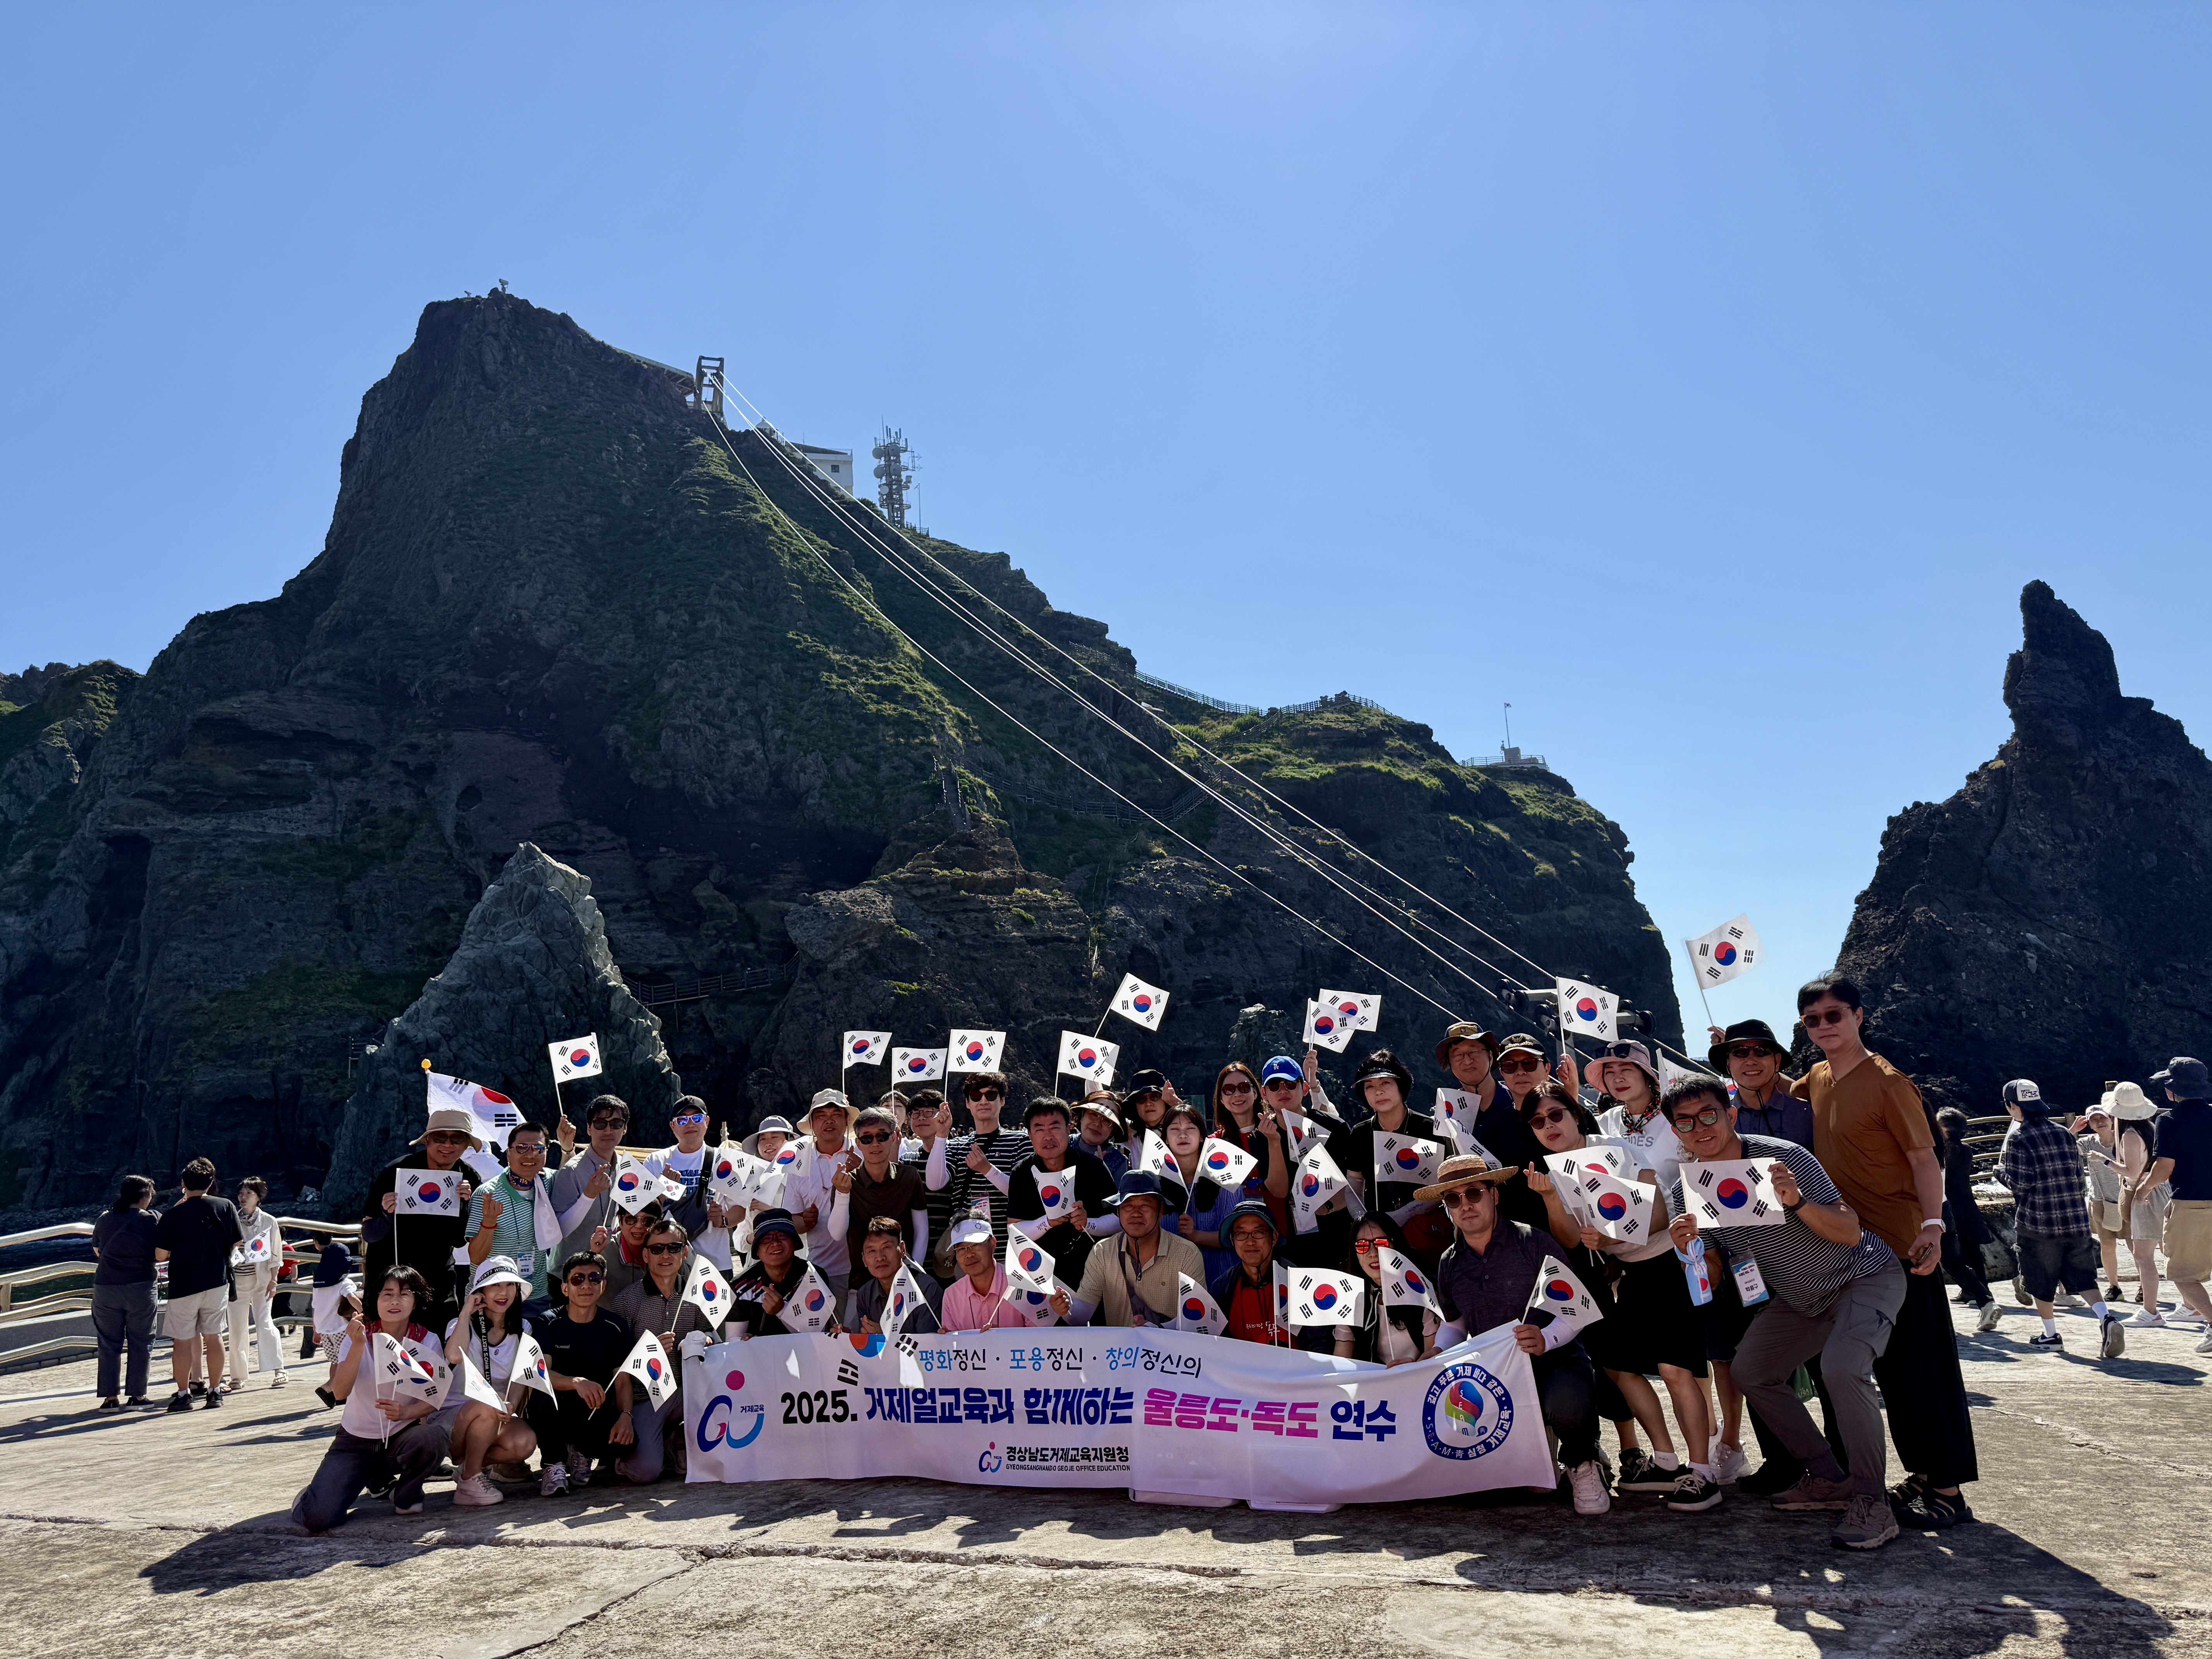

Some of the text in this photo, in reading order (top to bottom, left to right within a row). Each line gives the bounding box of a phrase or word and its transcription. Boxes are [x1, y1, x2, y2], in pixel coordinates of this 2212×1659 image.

[919, 1346, 1201, 1379] 평화정신 포용정신 창의정신의
[1437, 1369, 1455, 1386] 푸른
[1456, 1366, 1472, 1377] 거제
[1472, 1367, 1487, 1383] 바다
[1486, 1379, 1504, 1397] 같은
[740, 1404, 764, 1413] 거제교육
[781, 1389, 858, 1424] 2025.
[864, 1387, 1014, 1424] 거제얼교육과
[1024, 1386, 1134, 1425] 함께하는
[1330, 1400, 1396, 1442] 연수
[1467, 1444, 1487, 1458] 심청
[1486, 1410, 1511, 1448] 거제교육
[1006, 1446, 1129, 1463] 경상남도거제교육지원청
